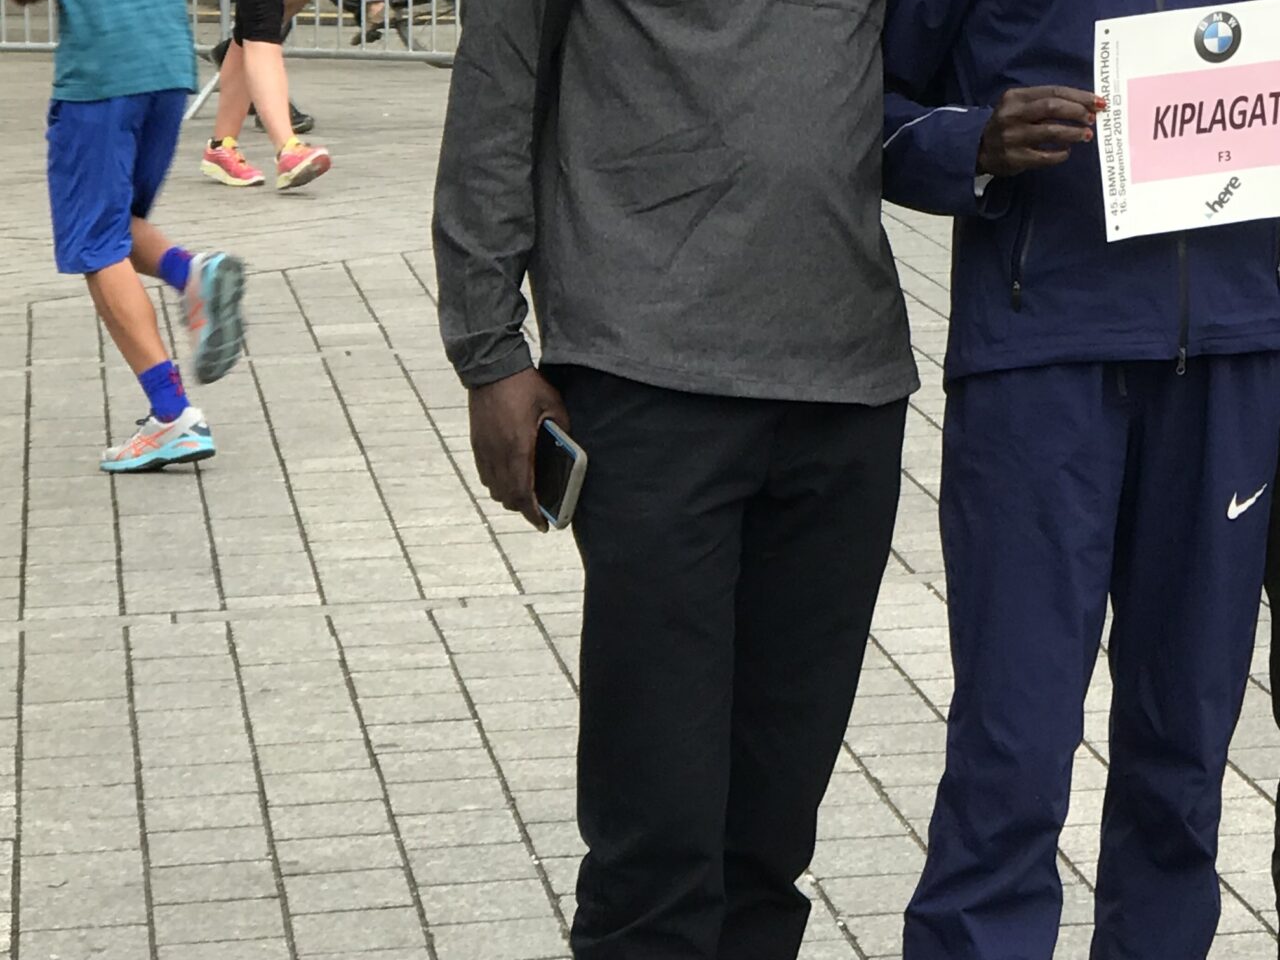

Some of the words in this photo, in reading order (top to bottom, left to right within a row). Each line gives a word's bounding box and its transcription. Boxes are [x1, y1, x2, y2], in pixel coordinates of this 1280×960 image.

[1113, 109, 1122, 135] 2018
[1116, 138, 1127, 196] September
[1217, 150, 1232, 162] F3
[1107, 166, 1117, 196] BMW
[1204, 176, 1241, 213] here
